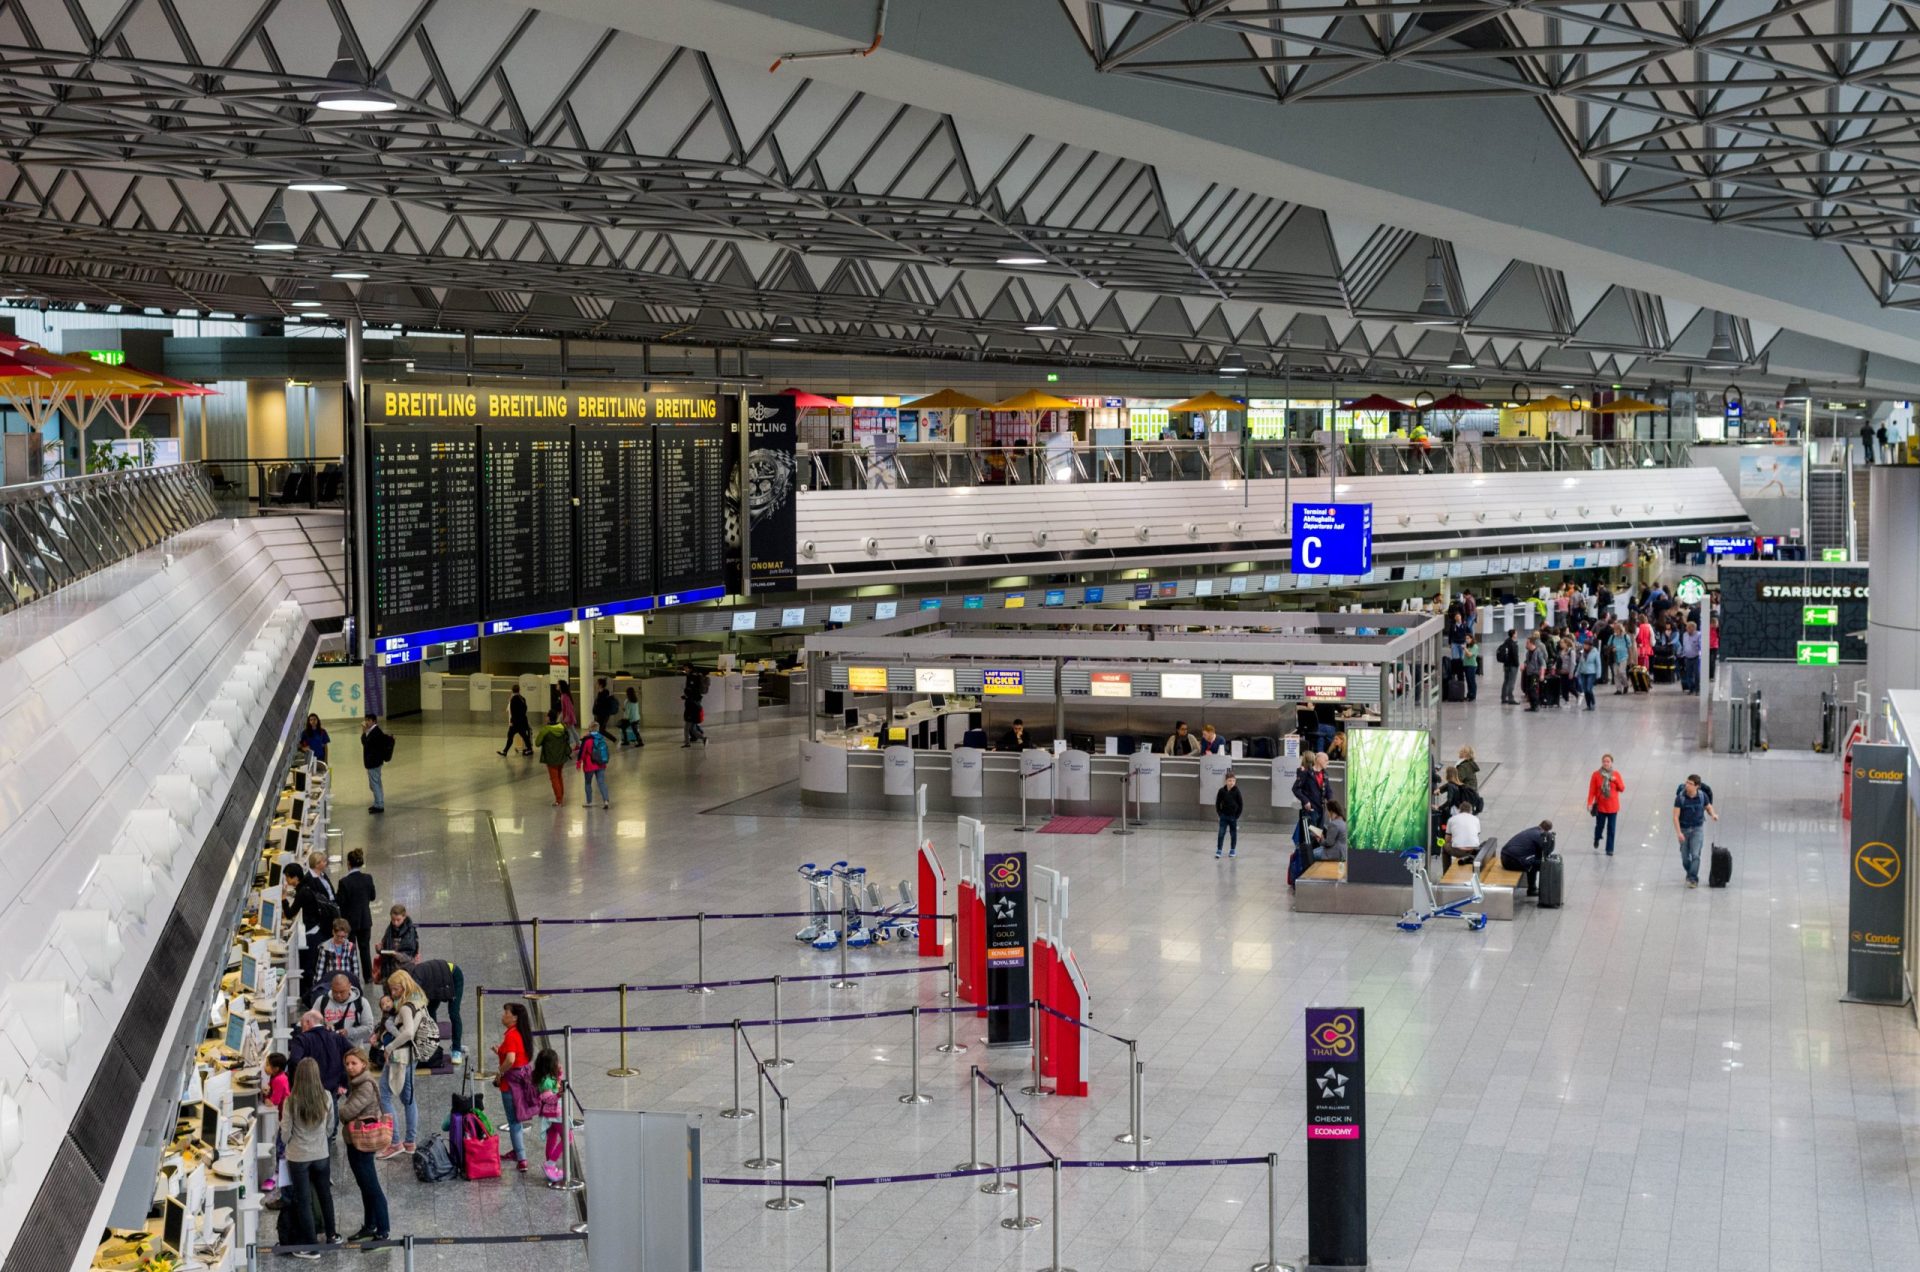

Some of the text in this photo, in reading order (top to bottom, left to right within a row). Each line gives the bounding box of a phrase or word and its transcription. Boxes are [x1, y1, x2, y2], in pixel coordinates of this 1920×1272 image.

[385, 392, 477, 416] BREITLING
[488, 394, 567, 417] BREITLING
[578, 396, 646, 417] BREITLING
[655, 398, 717, 418] BREITLING
[731, 422, 787, 433] BEITLING
[1302, 536, 1322, 568] C
[1763, 586, 1852, 597] STARBUCKS
[986, 677, 1020, 685] TICKET
[1868, 769, 1904, 781] Condor
[996, 930, 1015, 938] GOLD
[1865, 932, 1901, 945] Condor
[1312, 1048, 1333, 1056] THAI
[1315, 1115, 1352, 1123] CHECK IN
[1314, 1127, 1352, 1136] ECONOMY
